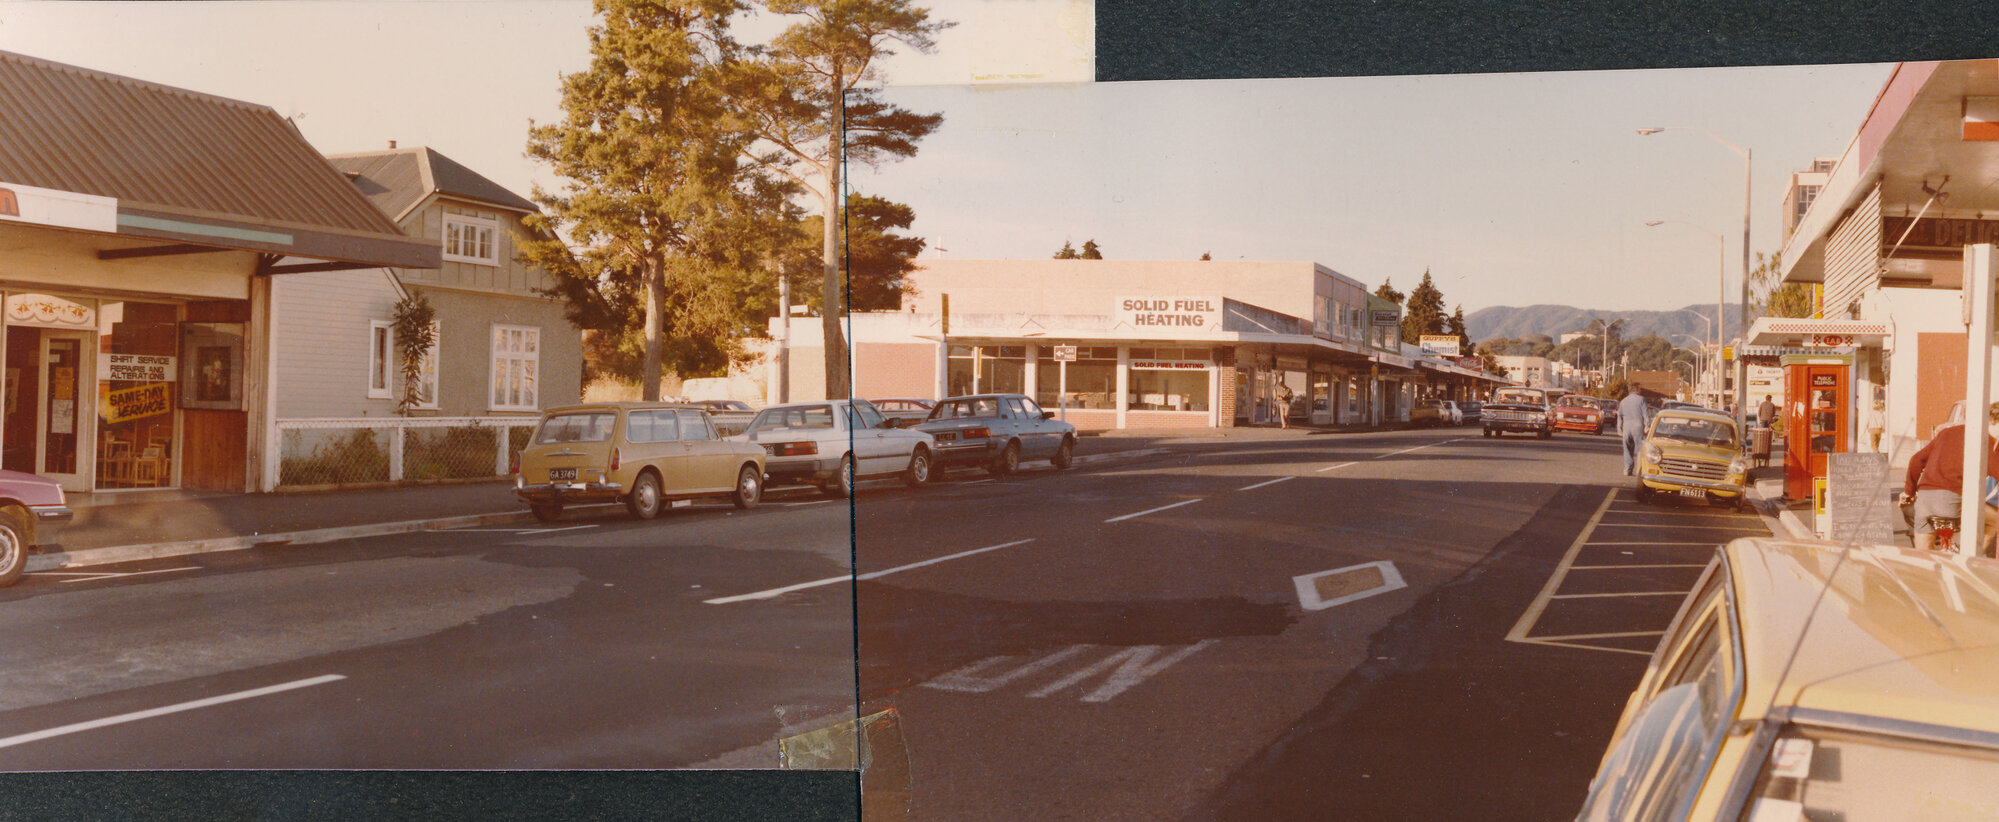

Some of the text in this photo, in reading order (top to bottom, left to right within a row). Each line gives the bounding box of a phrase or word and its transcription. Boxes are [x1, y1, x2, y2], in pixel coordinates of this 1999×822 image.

[1123, 299, 1215, 312] SOLID FUEL
[1135, 313, 1205, 327] HEATING
[1422, 342, 1458, 354] Chemist
[110, 355, 170, 365] SHIRT SERVICE
[110, 364, 146, 373] REPAIRS
[110, 372, 165, 380] ALTERATIONS
[109, 385, 165, 407] SAME-DAY
